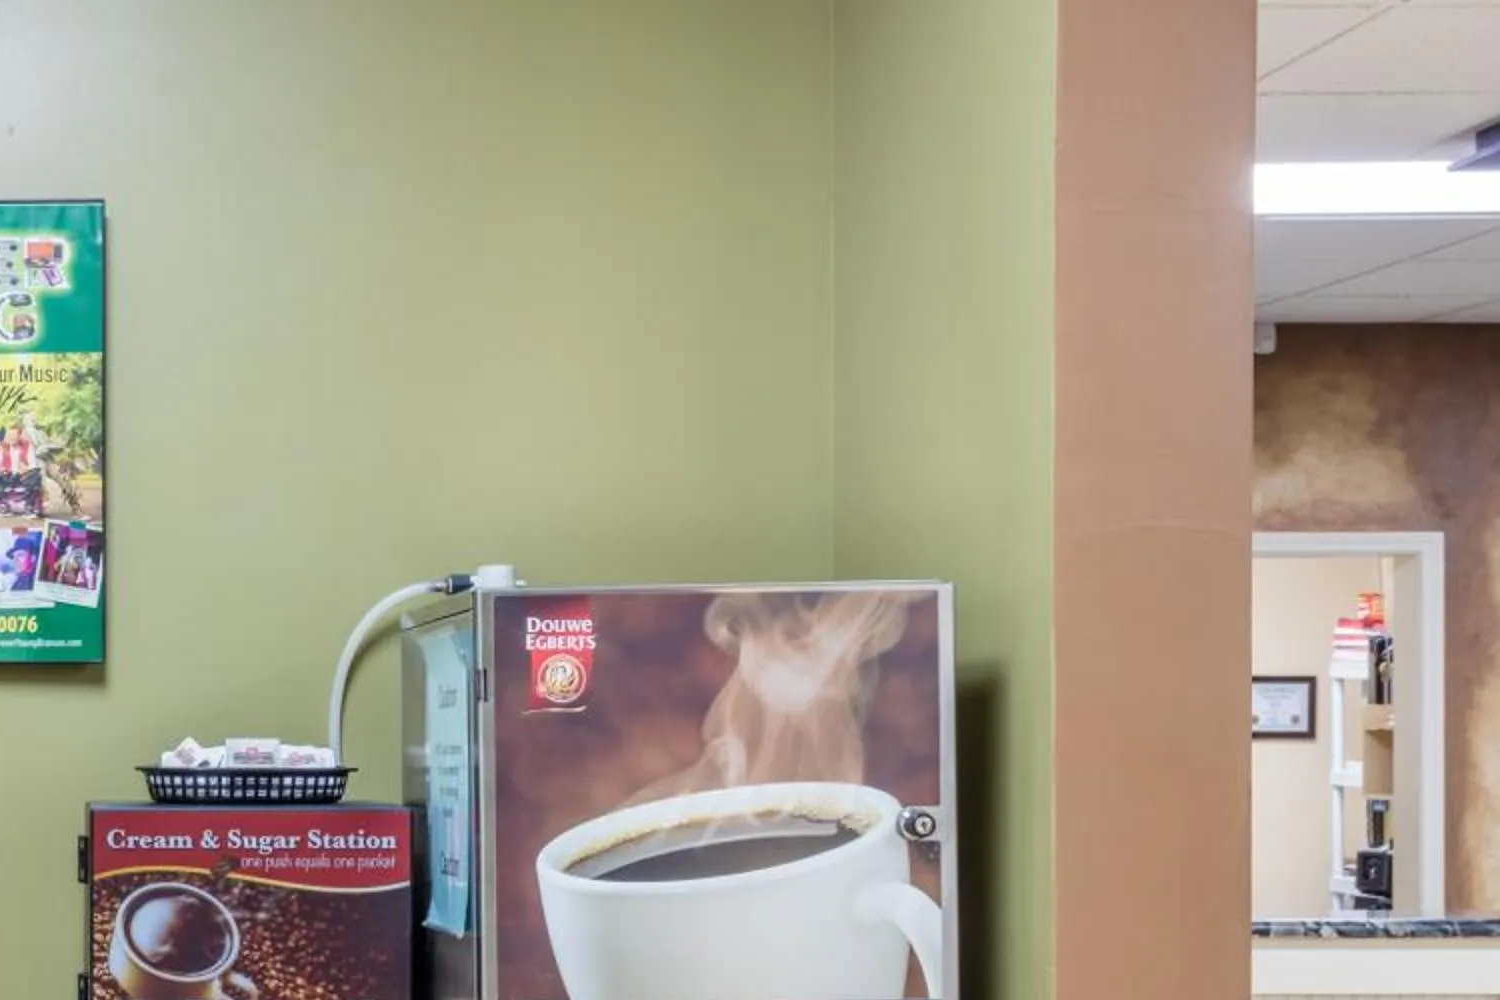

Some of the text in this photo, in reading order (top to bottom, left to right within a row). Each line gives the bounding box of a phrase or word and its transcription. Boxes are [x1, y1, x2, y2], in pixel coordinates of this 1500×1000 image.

[19, 364, 69, 383] Music
[106, 828, 397, 854] Cream & Sugar Station
[240, 853, 396, 873] one push equals one packet
